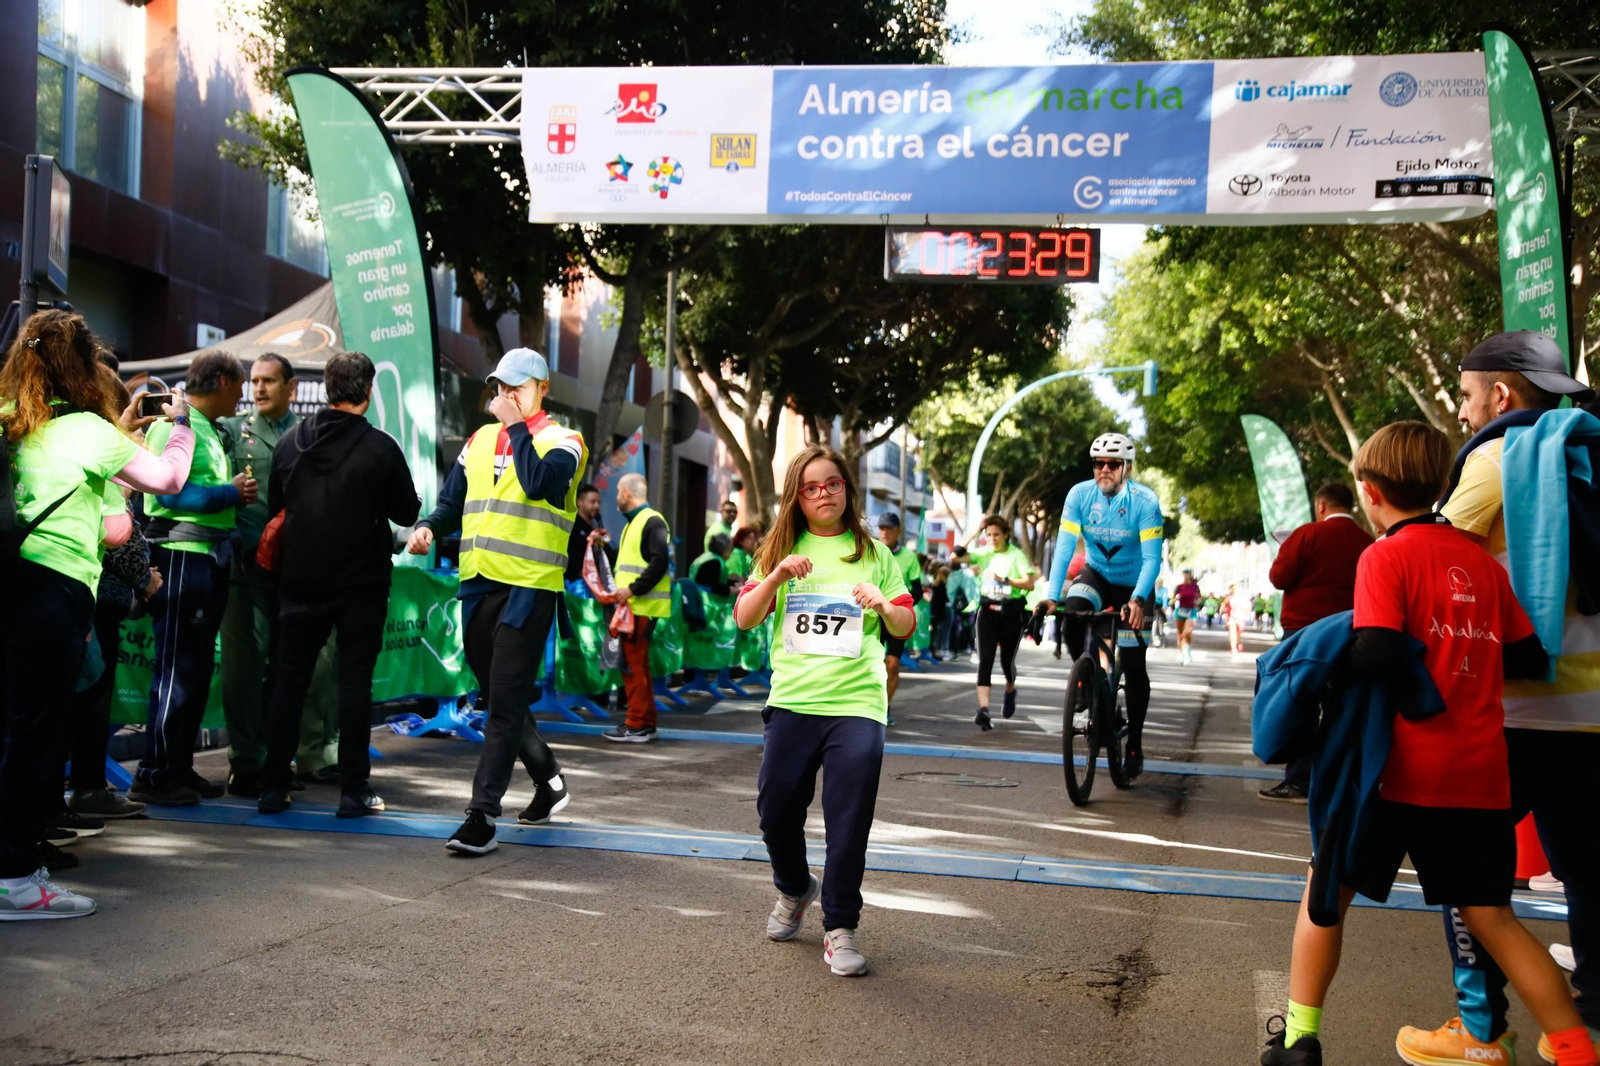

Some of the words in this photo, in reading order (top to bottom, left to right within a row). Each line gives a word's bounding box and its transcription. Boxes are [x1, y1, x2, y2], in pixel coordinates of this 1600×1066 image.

[1418, 78, 1487, 88] UNIVERSIDA
[1266, 80, 1353, 102] cajamar
[1418, 89, 1434, 98] DE
[1439, 87, 1488, 97] ALMERÍ
[798, 82, 953, 116] Almería
[966, 88, 1013, 112] en
[1028, 79, 1184, 112] marcha
[715, 137, 751, 150] SOLAN
[797, 127, 925, 160] contra
[936, 125, 976, 159] el
[986, 125, 1130, 158] cáncer
[1347, 128, 1446, 147] Fundación
[1266, 140, 1324, 149] MICHELIN
[532, 160, 587, 174] ALMERÍA
[1396, 158, 1431, 175] Ejido
[1435, 158, 1480, 169] Motor
[1269, 173, 1311, 184] Toyota
[1109, 187, 1137, 196] contra
[1138, 187, 1147, 195] el
[1268, 186, 1317, 197] Alborán
[1319, 186, 1356, 196] Motor
[1417, 184, 1439, 193] Jeep
[1443, 182, 1459, 194] FIAT
[785, 190, 913, 202] #TodosContraElCáncer
[1108, 198, 1121, 206] en
[815, 581, 853, 592] march
[795, 613, 847, 636] 857
[1464, 1047, 1502, 1060] HOKA
